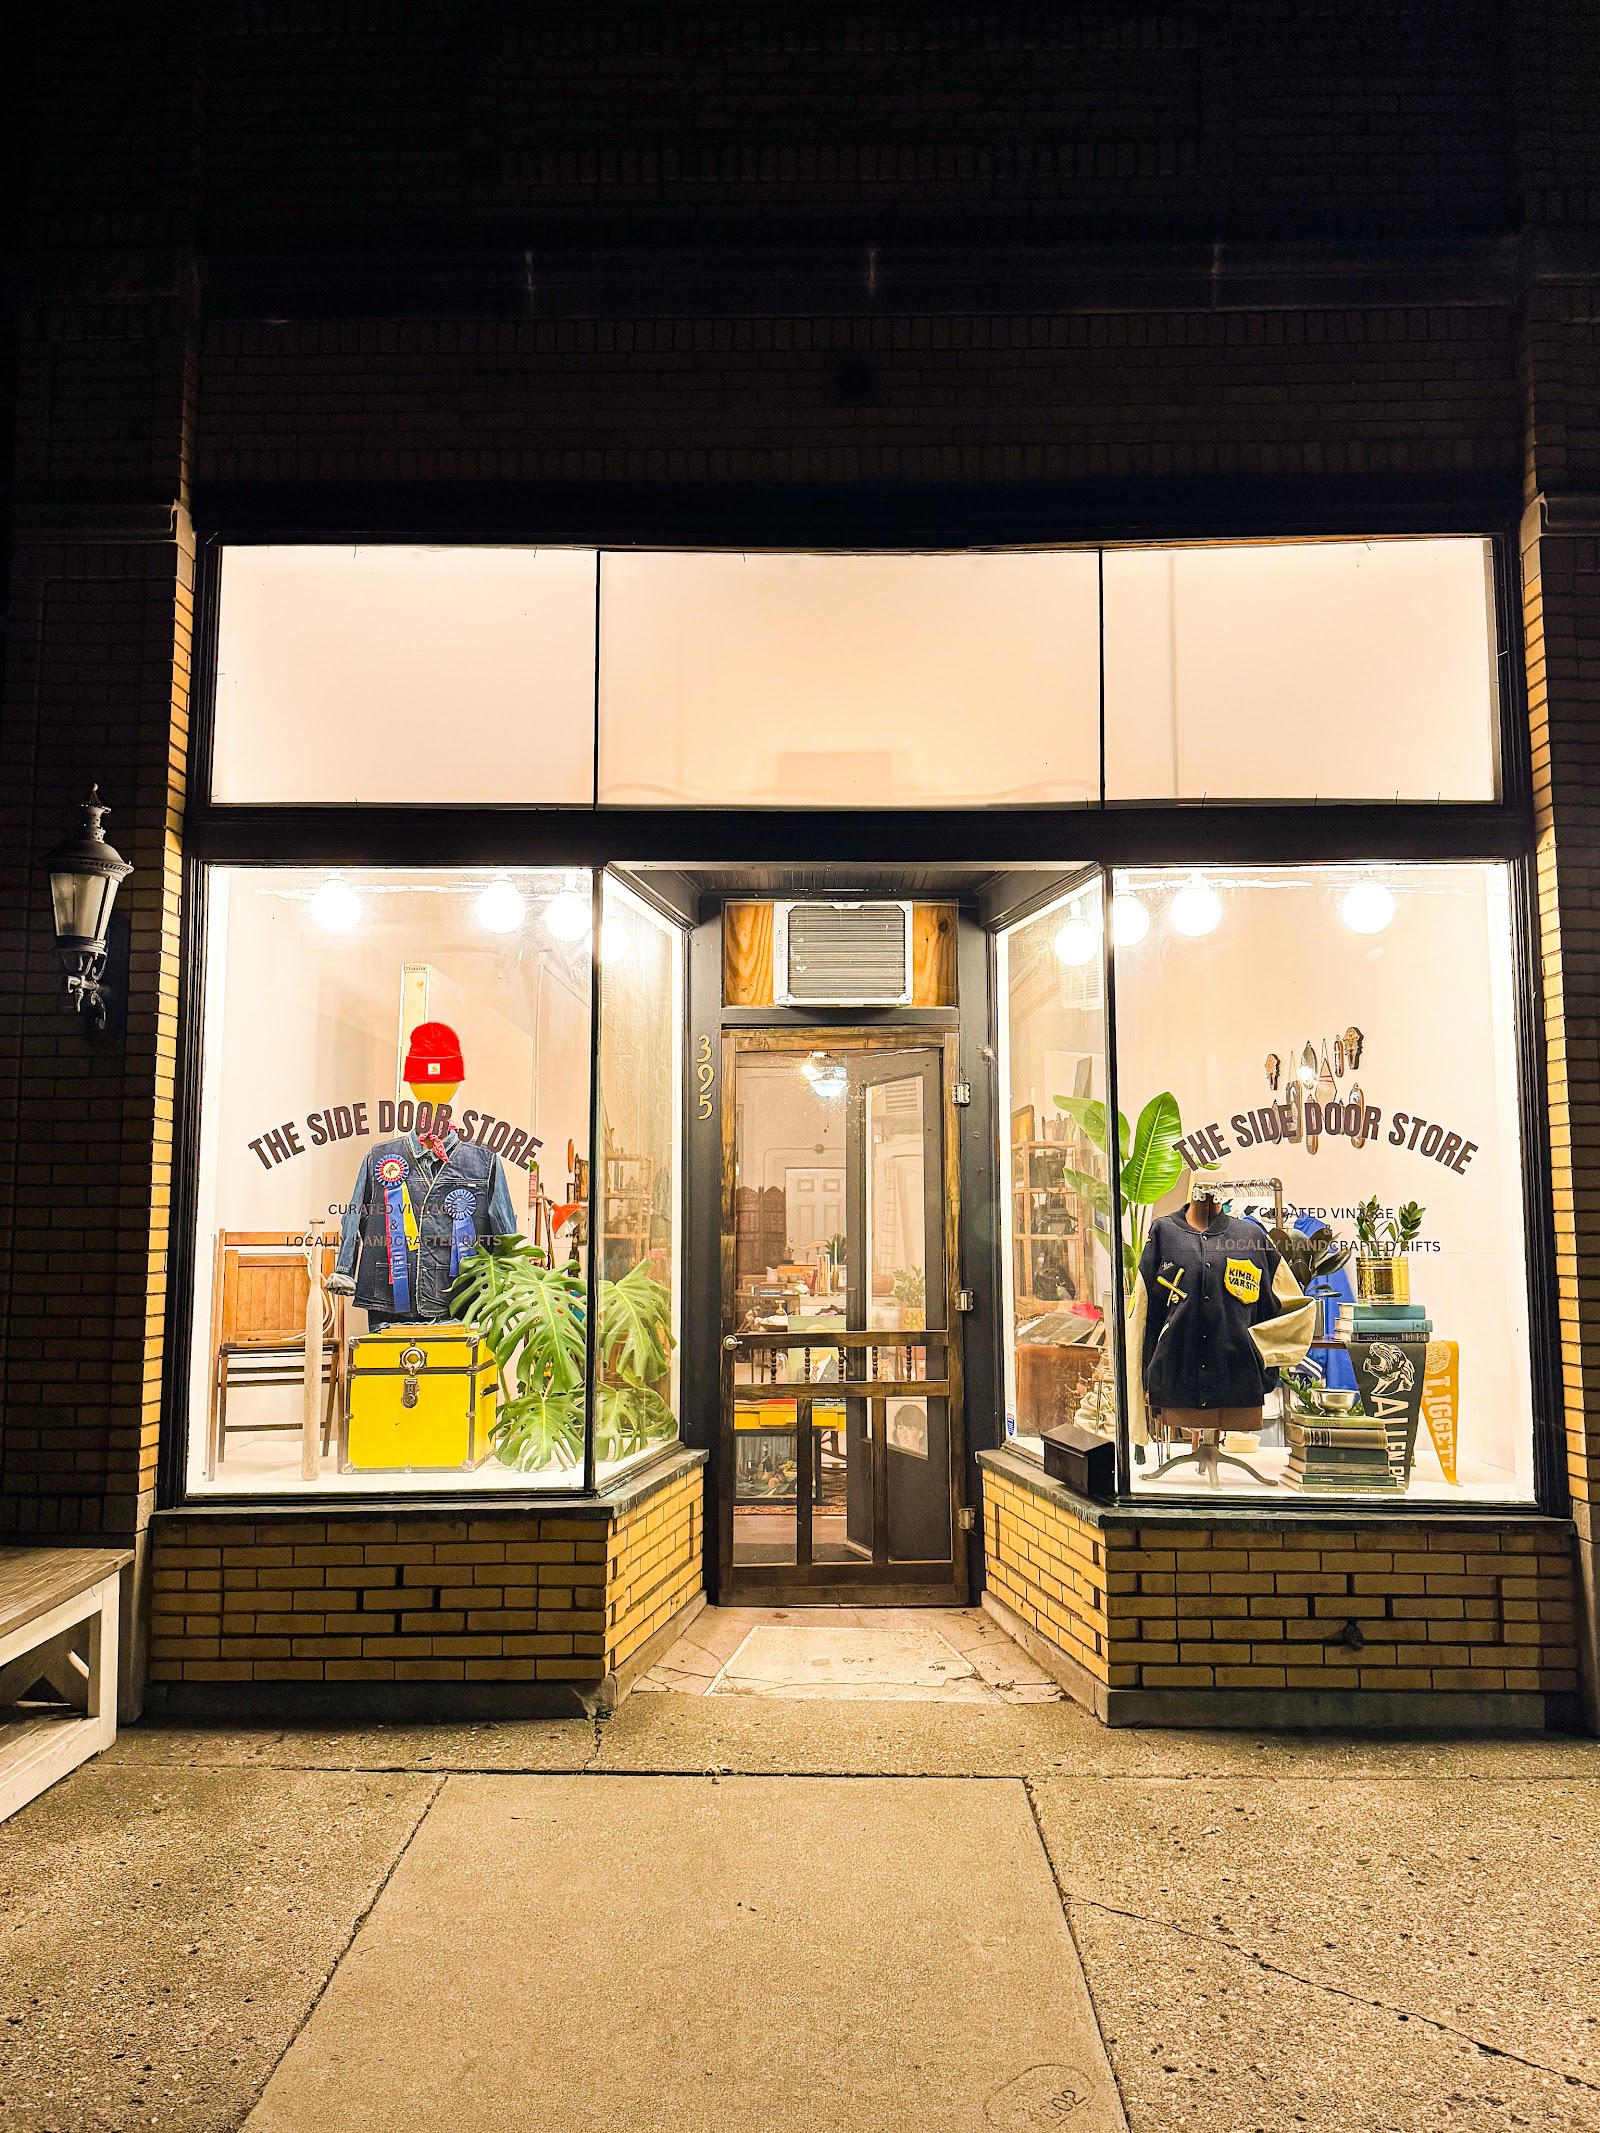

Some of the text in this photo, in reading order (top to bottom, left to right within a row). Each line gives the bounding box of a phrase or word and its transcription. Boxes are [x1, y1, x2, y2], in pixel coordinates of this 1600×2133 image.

[697, 1034, 715, 1120] 395
[247, 1100, 544, 1171] THE SIDE DOOR STORE
[1171, 1101, 1479, 1176] THE SIDE DOOR STORE
[328, 1203, 457, 1215] CURATED VINTAG
[1331, 1207, 1394, 1219] VINTGE
[389, 1219, 399, 1231] &
[285, 1234, 502, 1247] LOCALLY HANDCRAFTED GFTS
[1217, 1238, 1441, 1252] LOCALLY HANDCRAFTED GIFTS
[1423, 1375, 1455, 1471] LIGGETT
